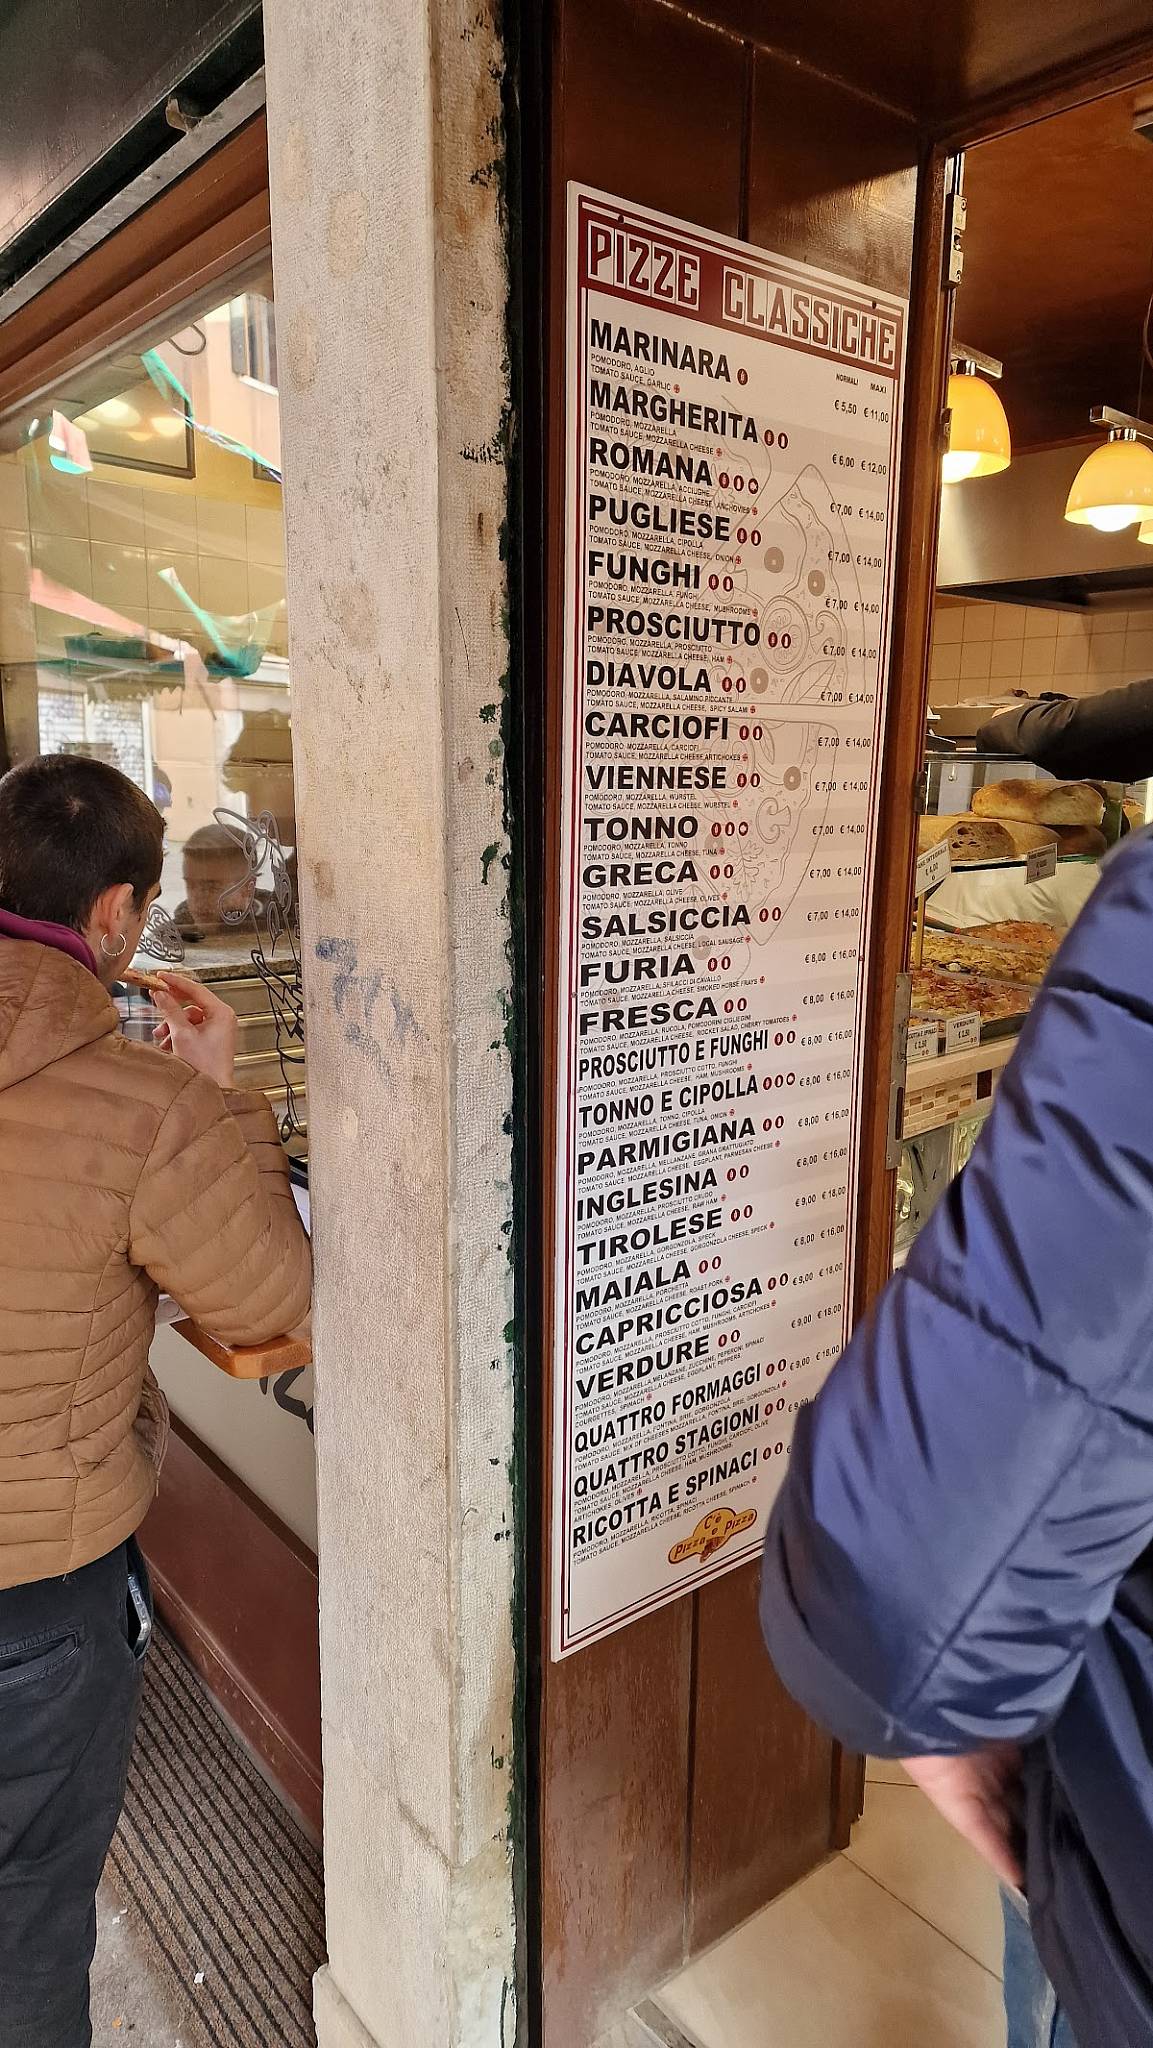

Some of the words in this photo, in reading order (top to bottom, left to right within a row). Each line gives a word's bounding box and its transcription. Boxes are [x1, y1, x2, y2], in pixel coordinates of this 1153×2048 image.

[590, 224, 699, 307] PIZZE
[722, 268, 895, 366] CLASSICHE
[590, 318, 731, 382] MARINARA
[590, 363, 619, 378] TOMATO
[647, 377, 670, 391] GARLIC
[634, 364, 654, 376] AGLIO
[835, 372, 858, 386] NORMALI
[870, 382, 886, 394] MAXI
[590, 378, 758, 443] MARGHERITA
[834, 399, 839, 410] €
[841, 401, 856, 415] 5,50
[863, 407, 868, 417] €
[590, 421, 618, 434] TOMATO
[645, 433, 688, 449] MOZZARELLA
[689, 443, 713, 455] CHEESE
[633, 420, 676, 437] MOZZARELLA
[589, 436, 713, 486] ROMANA
[832, 453, 836, 464] €
[839, 455, 854, 469] 6,00
[860, 460, 865, 470] €
[589, 494, 730, 541] PUGLIESE
[588, 550, 700, 589] FUNGHI
[588, 590, 614, 601] TOMATO
[642, 596, 684, 608] MOZZARELLA
[587, 605, 760, 646] PROSCIUTTO
[674, 642, 712, 652] PROSCIUTTO
[587, 660, 711, 692] DIAVOLA
[587, 699, 613, 707] TOMATO
[640, 701, 680, 709] MOZZARELLA
[820, 691, 825, 700] €
[826, 691, 842, 702] 7,00
[848, 693, 853, 702] €
[585, 711, 728, 740] CARCIOFI
[817, 737, 822, 746] €
[824, 737, 839, 748] 7,00
[845, 737, 850, 746] €
[584, 765, 726, 789] VIENNESE
[815, 782, 819, 790] €
[821, 781, 836, 791] 7,00
[842, 781, 847, 790] €
[583, 815, 698, 841] TONNO
[635, 850, 675, 858] MOZZARELLA
[702, 848, 717, 856] TUNA
[582, 859, 698, 888] GRECA
[581, 903, 751, 940] SALSICCIA
[580, 952, 695, 987] FURIA
[804, 954, 809, 963] €
[811, 952, 825, 963] 8,00
[832, 951, 836, 959] €
[802, 995, 807, 1005] €
[809, 993, 823, 1005] 8,00
[830, 992, 834, 1001] €
[579, 995, 718, 1036] FRESCA
[800, 1037, 805, 1046] €
[807, 1034, 822, 1046] 8,00
[828, 1032, 832, 1041] €
[579, 1041, 689, 1081] PROSCIUTTO
[695, 1039, 705, 1060] E
[710, 1029, 768, 1058] FUNGHI
[799, 1078, 804, 1087] €
[806, 1074, 820, 1086] 8,00
[826, 1072, 830, 1081] €
[578, 1093, 653, 1129] TONNO
[661, 1090, 672, 1112] E
[679, 1073, 758, 1109] CIPOLLA
[578, 1115, 756, 1176] PARMIGIANA
[796, 1158, 801, 1167] €
[802, 1154, 817, 1167] 8,00
[823, 1151, 827, 1160] €
[577, 1166, 717, 1221] INGLESINA
[795, 1198, 799, 1207] €
[801, 1193, 816, 1206] 9,00
[821, 1191, 825, 1200] €
[576, 1207, 722, 1267] TIROLESE
[576, 1257, 691, 1313] MAIALA
[792, 1277, 797, 1286] €
[798, 1271, 813, 1285] 9,00
[819, 1268, 823, 1277] €
[576, 1275, 762, 1356] CAPRICCIOSA
[575, 1333, 709, 1401] VERDURE
[789, 1362, 794, 1371] €
[796, 1356, 810, 1369] 9,00
[815, 1351, 820, 1361] €
[574, 1399, 665, 1454] QUATTRO
[672, 1362, 760, 1415] FORMAGGI
[574, 1440, 668, 1499] QUATTRO
[675, 1402, 758, 1456] STAGIONI
[573, 1489, 661, 1548] RICOTTA
[668, 1482, 679, 1505] E
[685, 1447, 757, 1497] SPINACI
[674, 1536, 706, 1560] Pizza
[724, 1512, 754, 1535] Pizza
